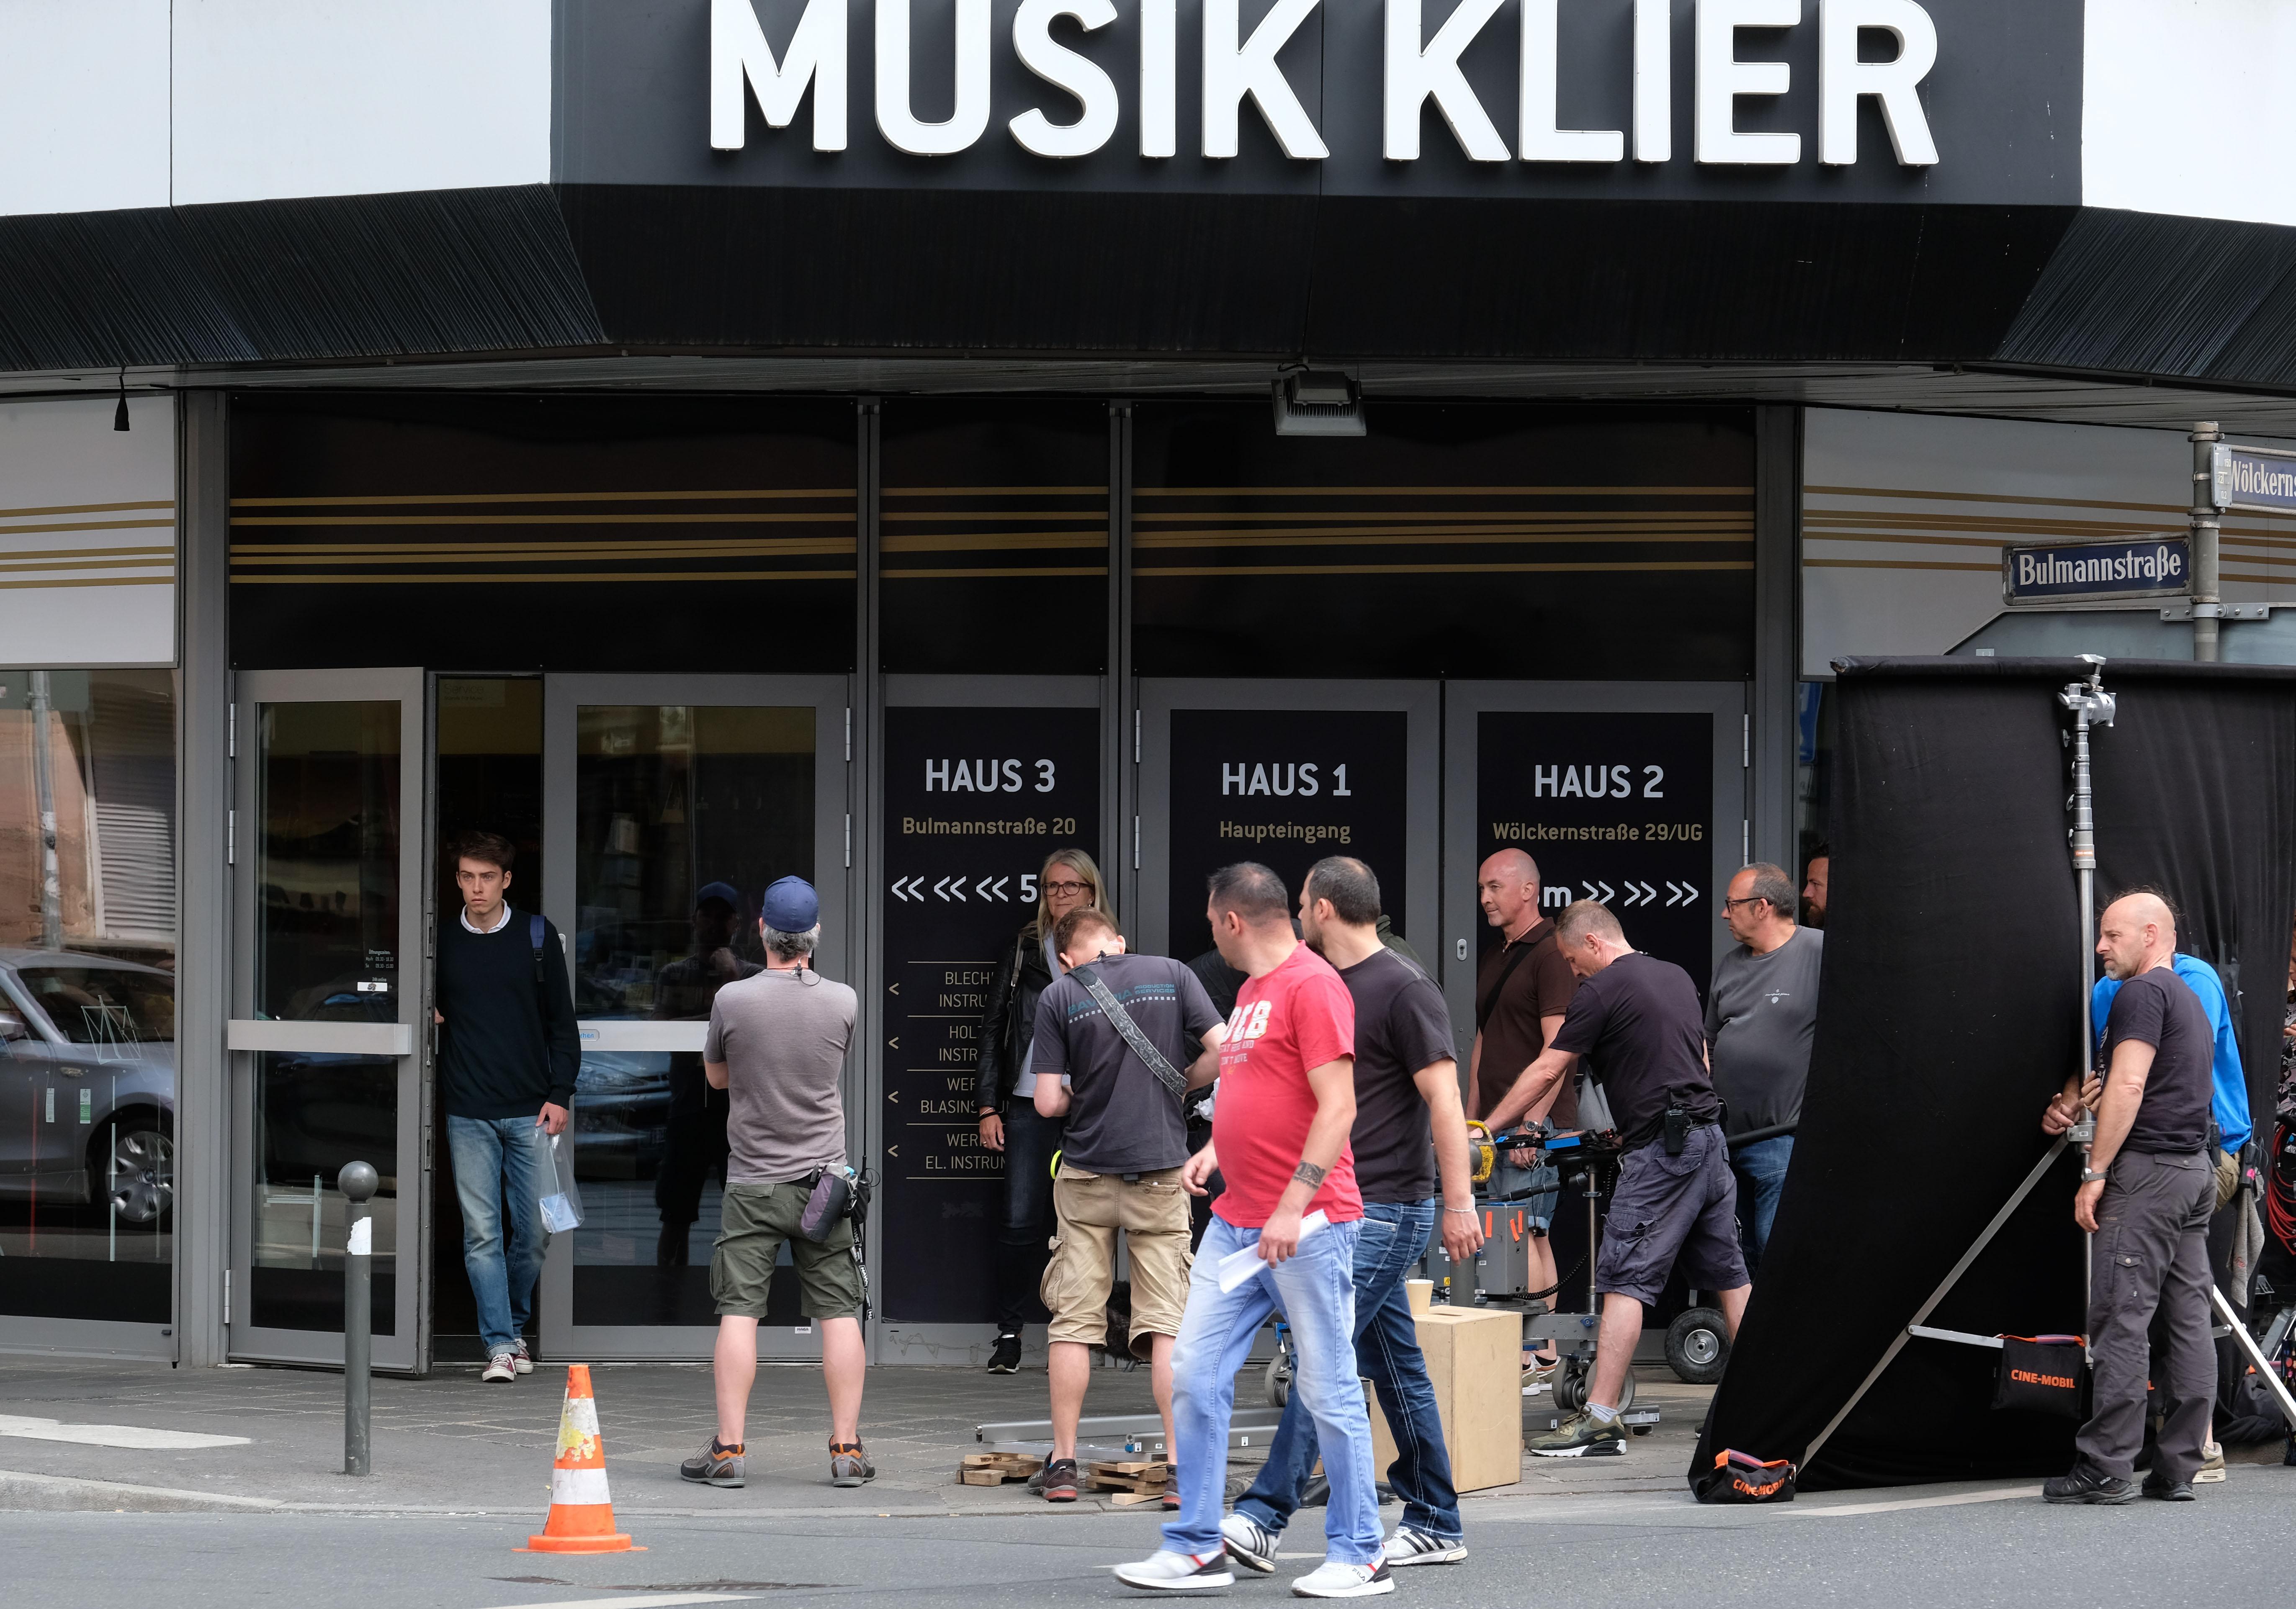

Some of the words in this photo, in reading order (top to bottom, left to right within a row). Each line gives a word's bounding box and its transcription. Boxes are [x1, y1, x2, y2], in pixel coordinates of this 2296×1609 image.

[710, 0, 1331, 161] MUSIK
[1383, 0, 1939, 166] KLIER
[2019, 545, 2181, 586] Bulmannstraße
[926, 759, 1022, 792] HAUS
[1035, 759, 1055, 792] 3
[1222, 762, 1319, 796] HAUS
[1333, 763, 1351, 796] 1
[1534, 764, 1631, 798] HAUS
[1643, 765, 1663, 798] 2
[903, 817, 1046, 835] Bulmannstraße
[1053, 817, 1076, 835] 20
[1220, 821, 1351, 843] Haupteingang
[1493, 822, 1639, 840] Wölckernstraße
[1645, 824, 1702, 841] 29/UG
[1537, 886, 1572, 907] m
[945, 971, 994, 985] BLECH
[1068, 989, 1133, 1016] BAVIA
[950, 1025, 982, 1039] HOL
[939, 1048, 978, 1062] INSTR
[947, 1133, 982, 1147] WER
[926, 1156, 946, 1169] EL.
[2010, 1369, 2075, 1389] CINE-MOBIL
[1351, 1567, 1365, 1581] FILA
